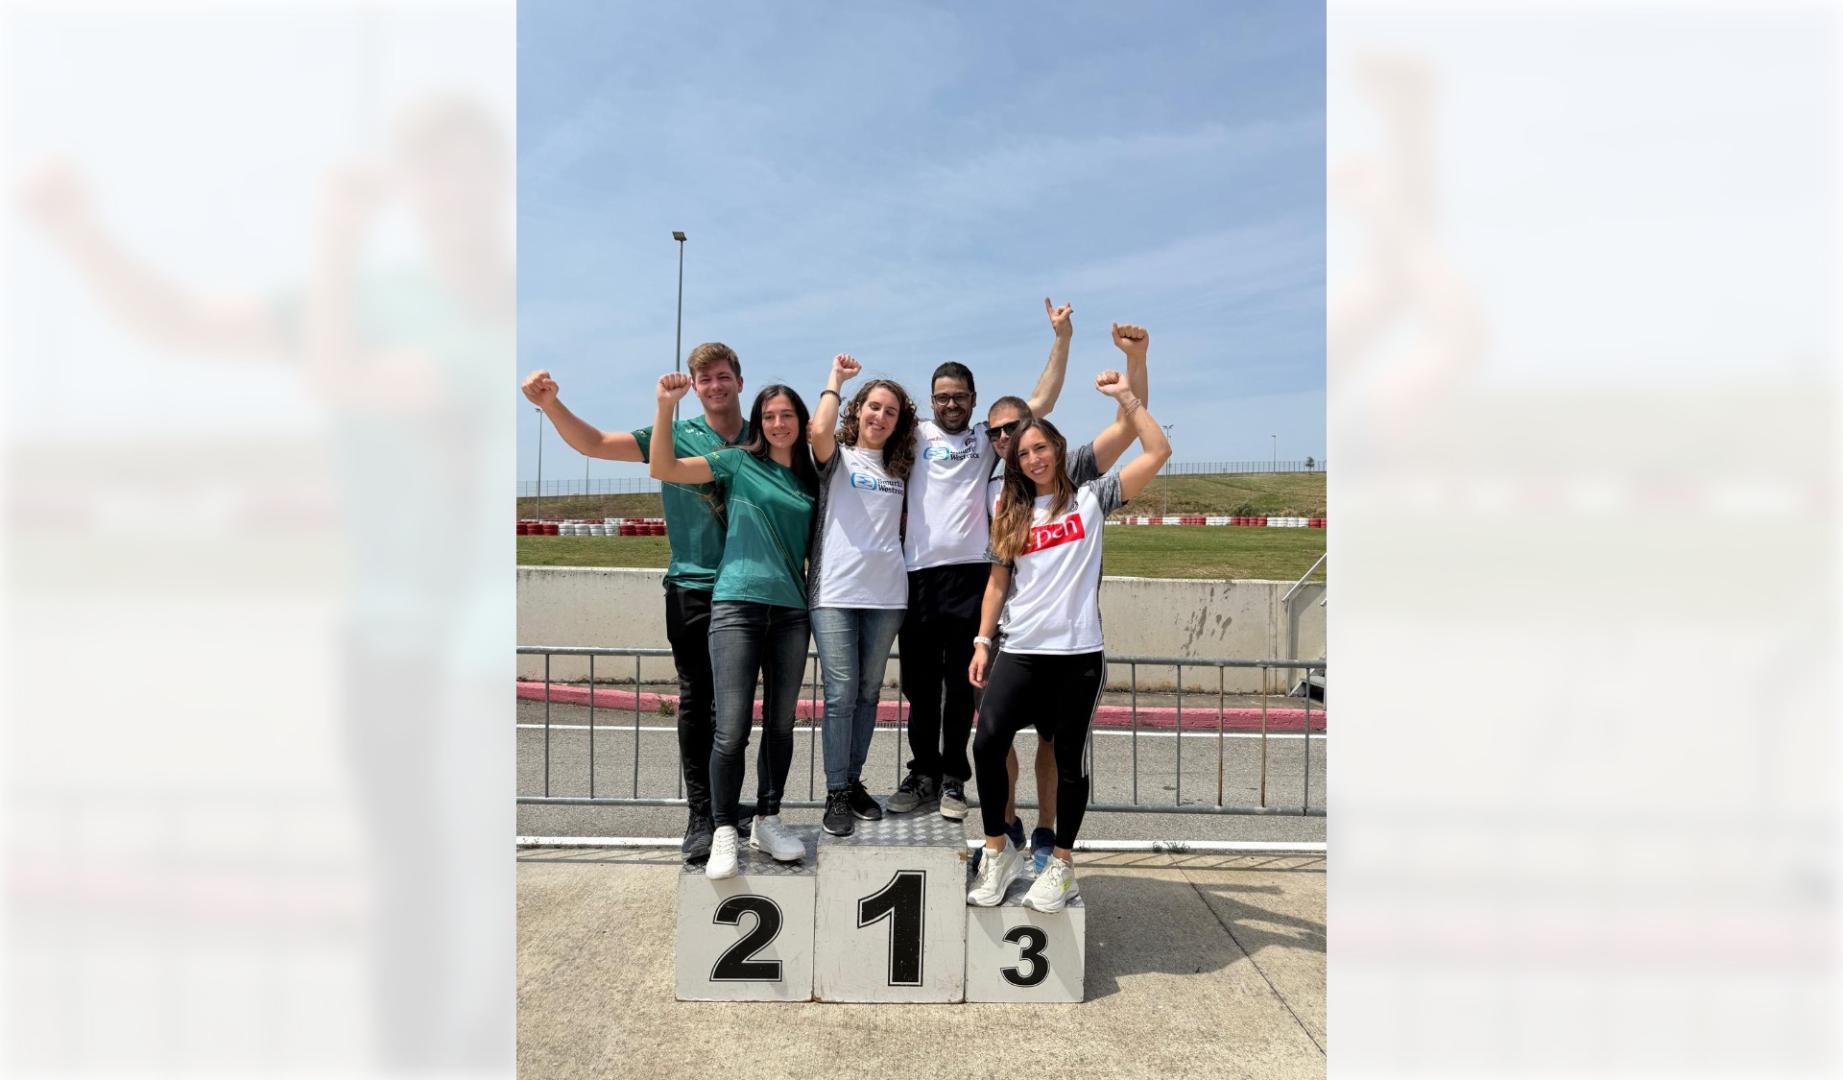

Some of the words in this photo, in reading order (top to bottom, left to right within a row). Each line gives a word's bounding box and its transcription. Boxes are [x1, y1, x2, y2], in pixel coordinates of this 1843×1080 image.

[709, 894, 783, 982] 2
[857, 869, 927, 987] 1
[1000, 925, 1051, 988] 3
